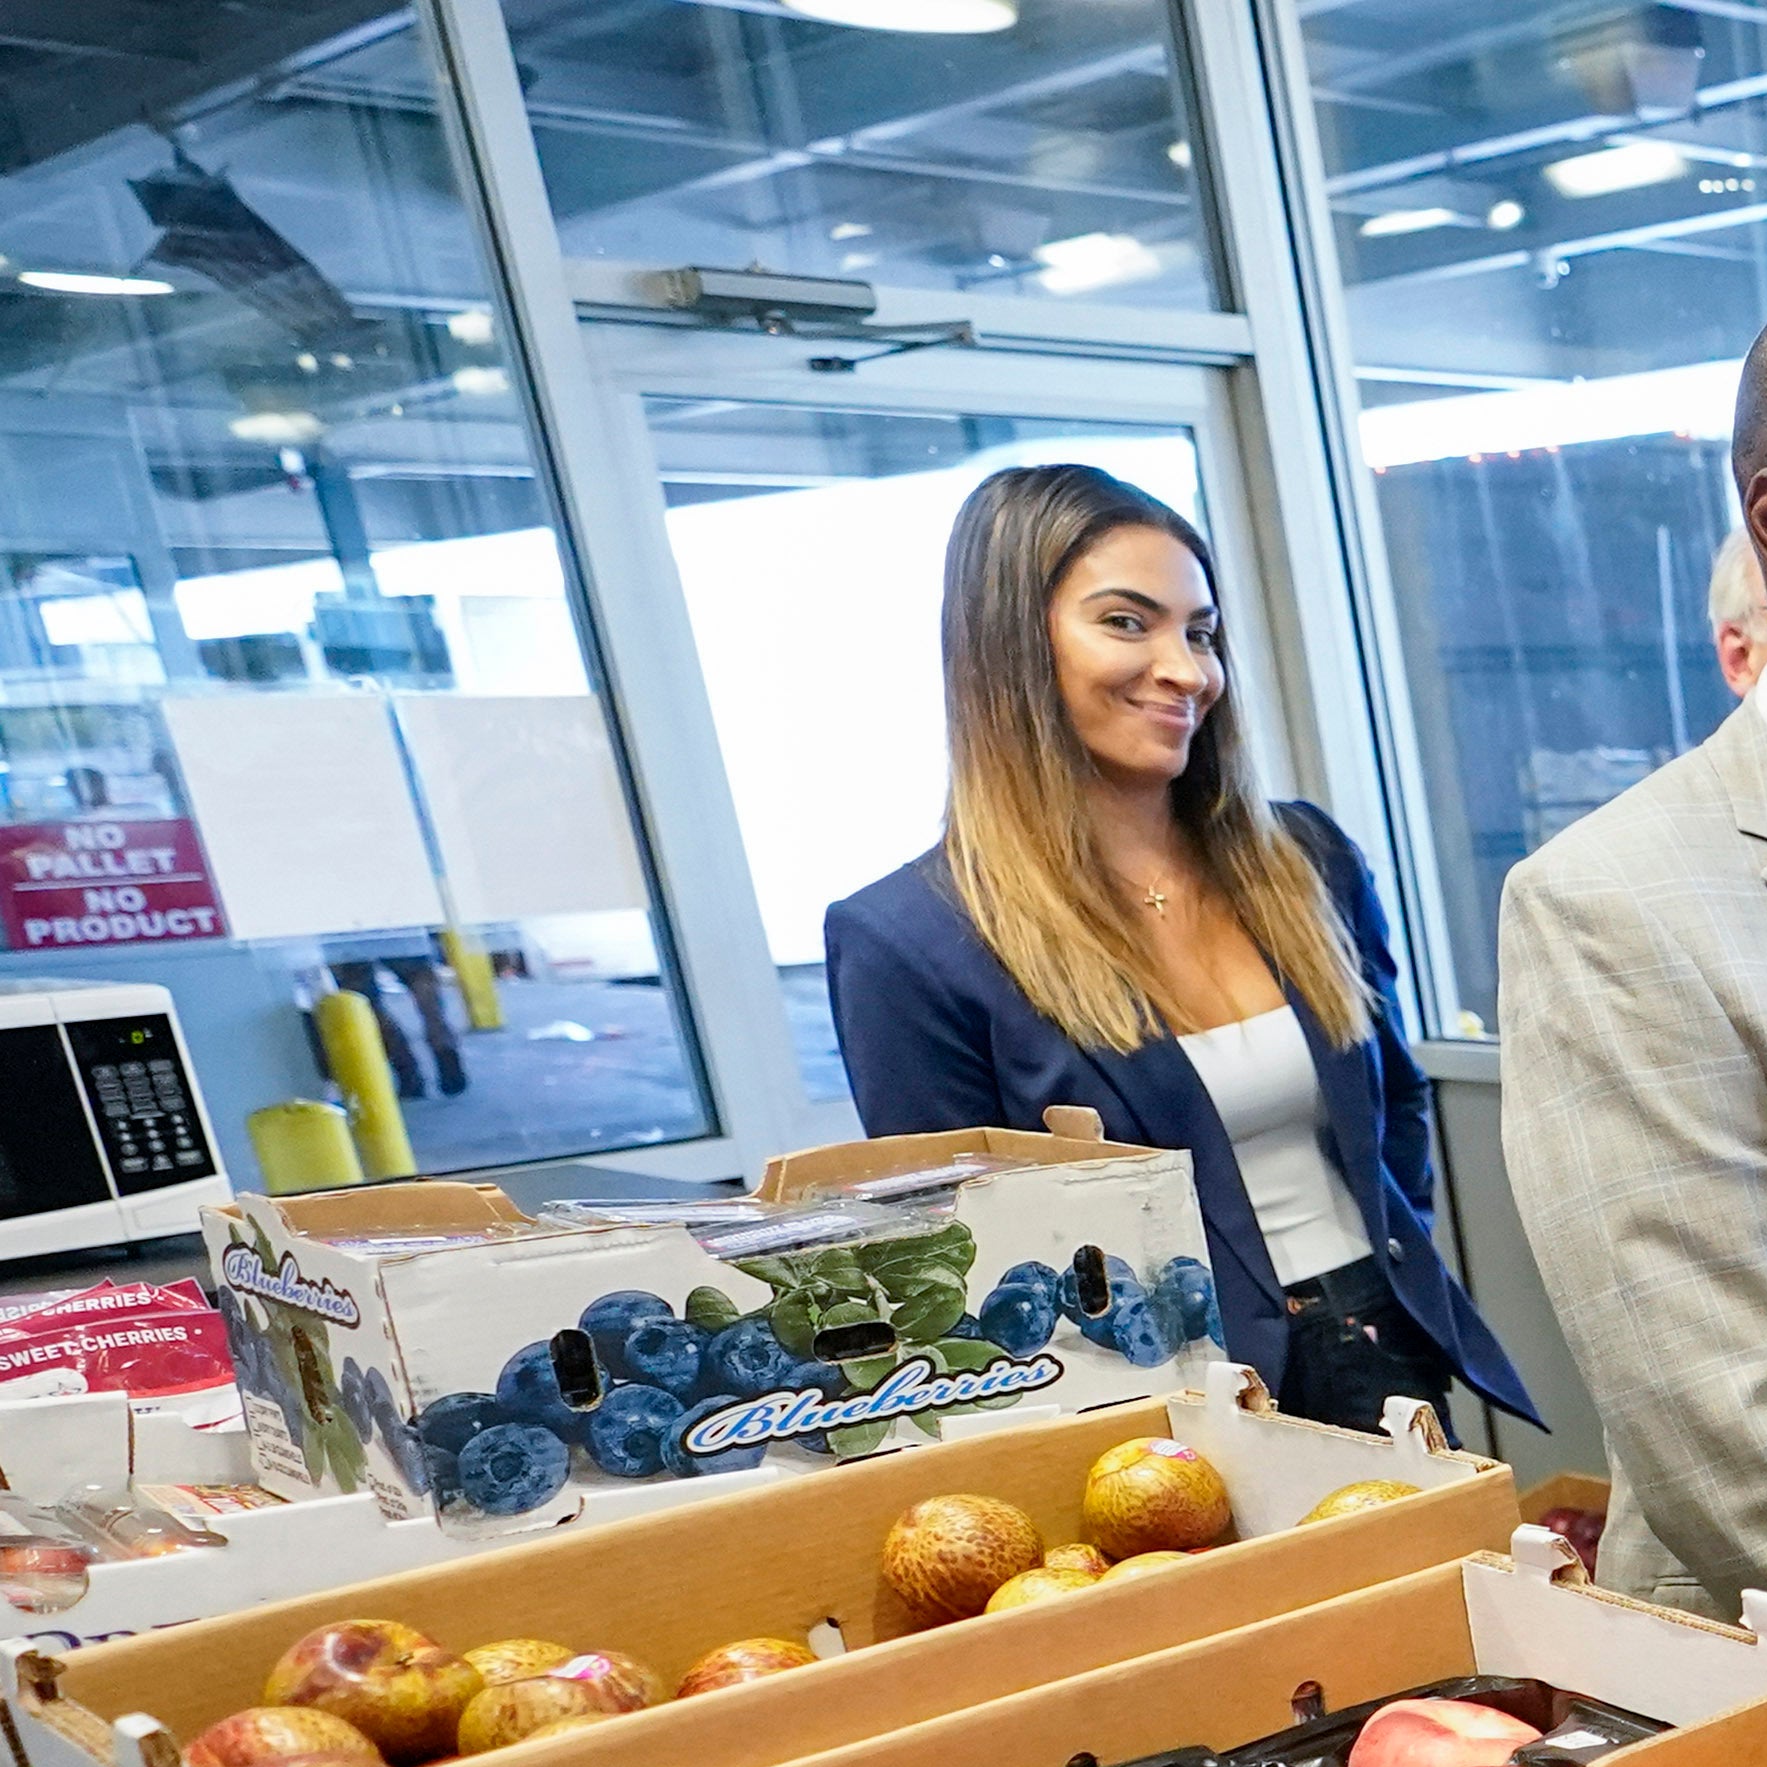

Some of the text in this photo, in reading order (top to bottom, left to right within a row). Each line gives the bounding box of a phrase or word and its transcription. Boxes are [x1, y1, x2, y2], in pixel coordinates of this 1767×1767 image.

[64, 824, 126, 850] NO
[25, 848, 177, 880] PALLET
[83, 886, 147, 913] NO
[23, 906, 217, 945] PRODUCT
[227, 1248, 358, 1320] Blueberries
[80, 1326, 188, 1353] CHERRIES
[688, 1357, 1059, 1452] Blueberries
